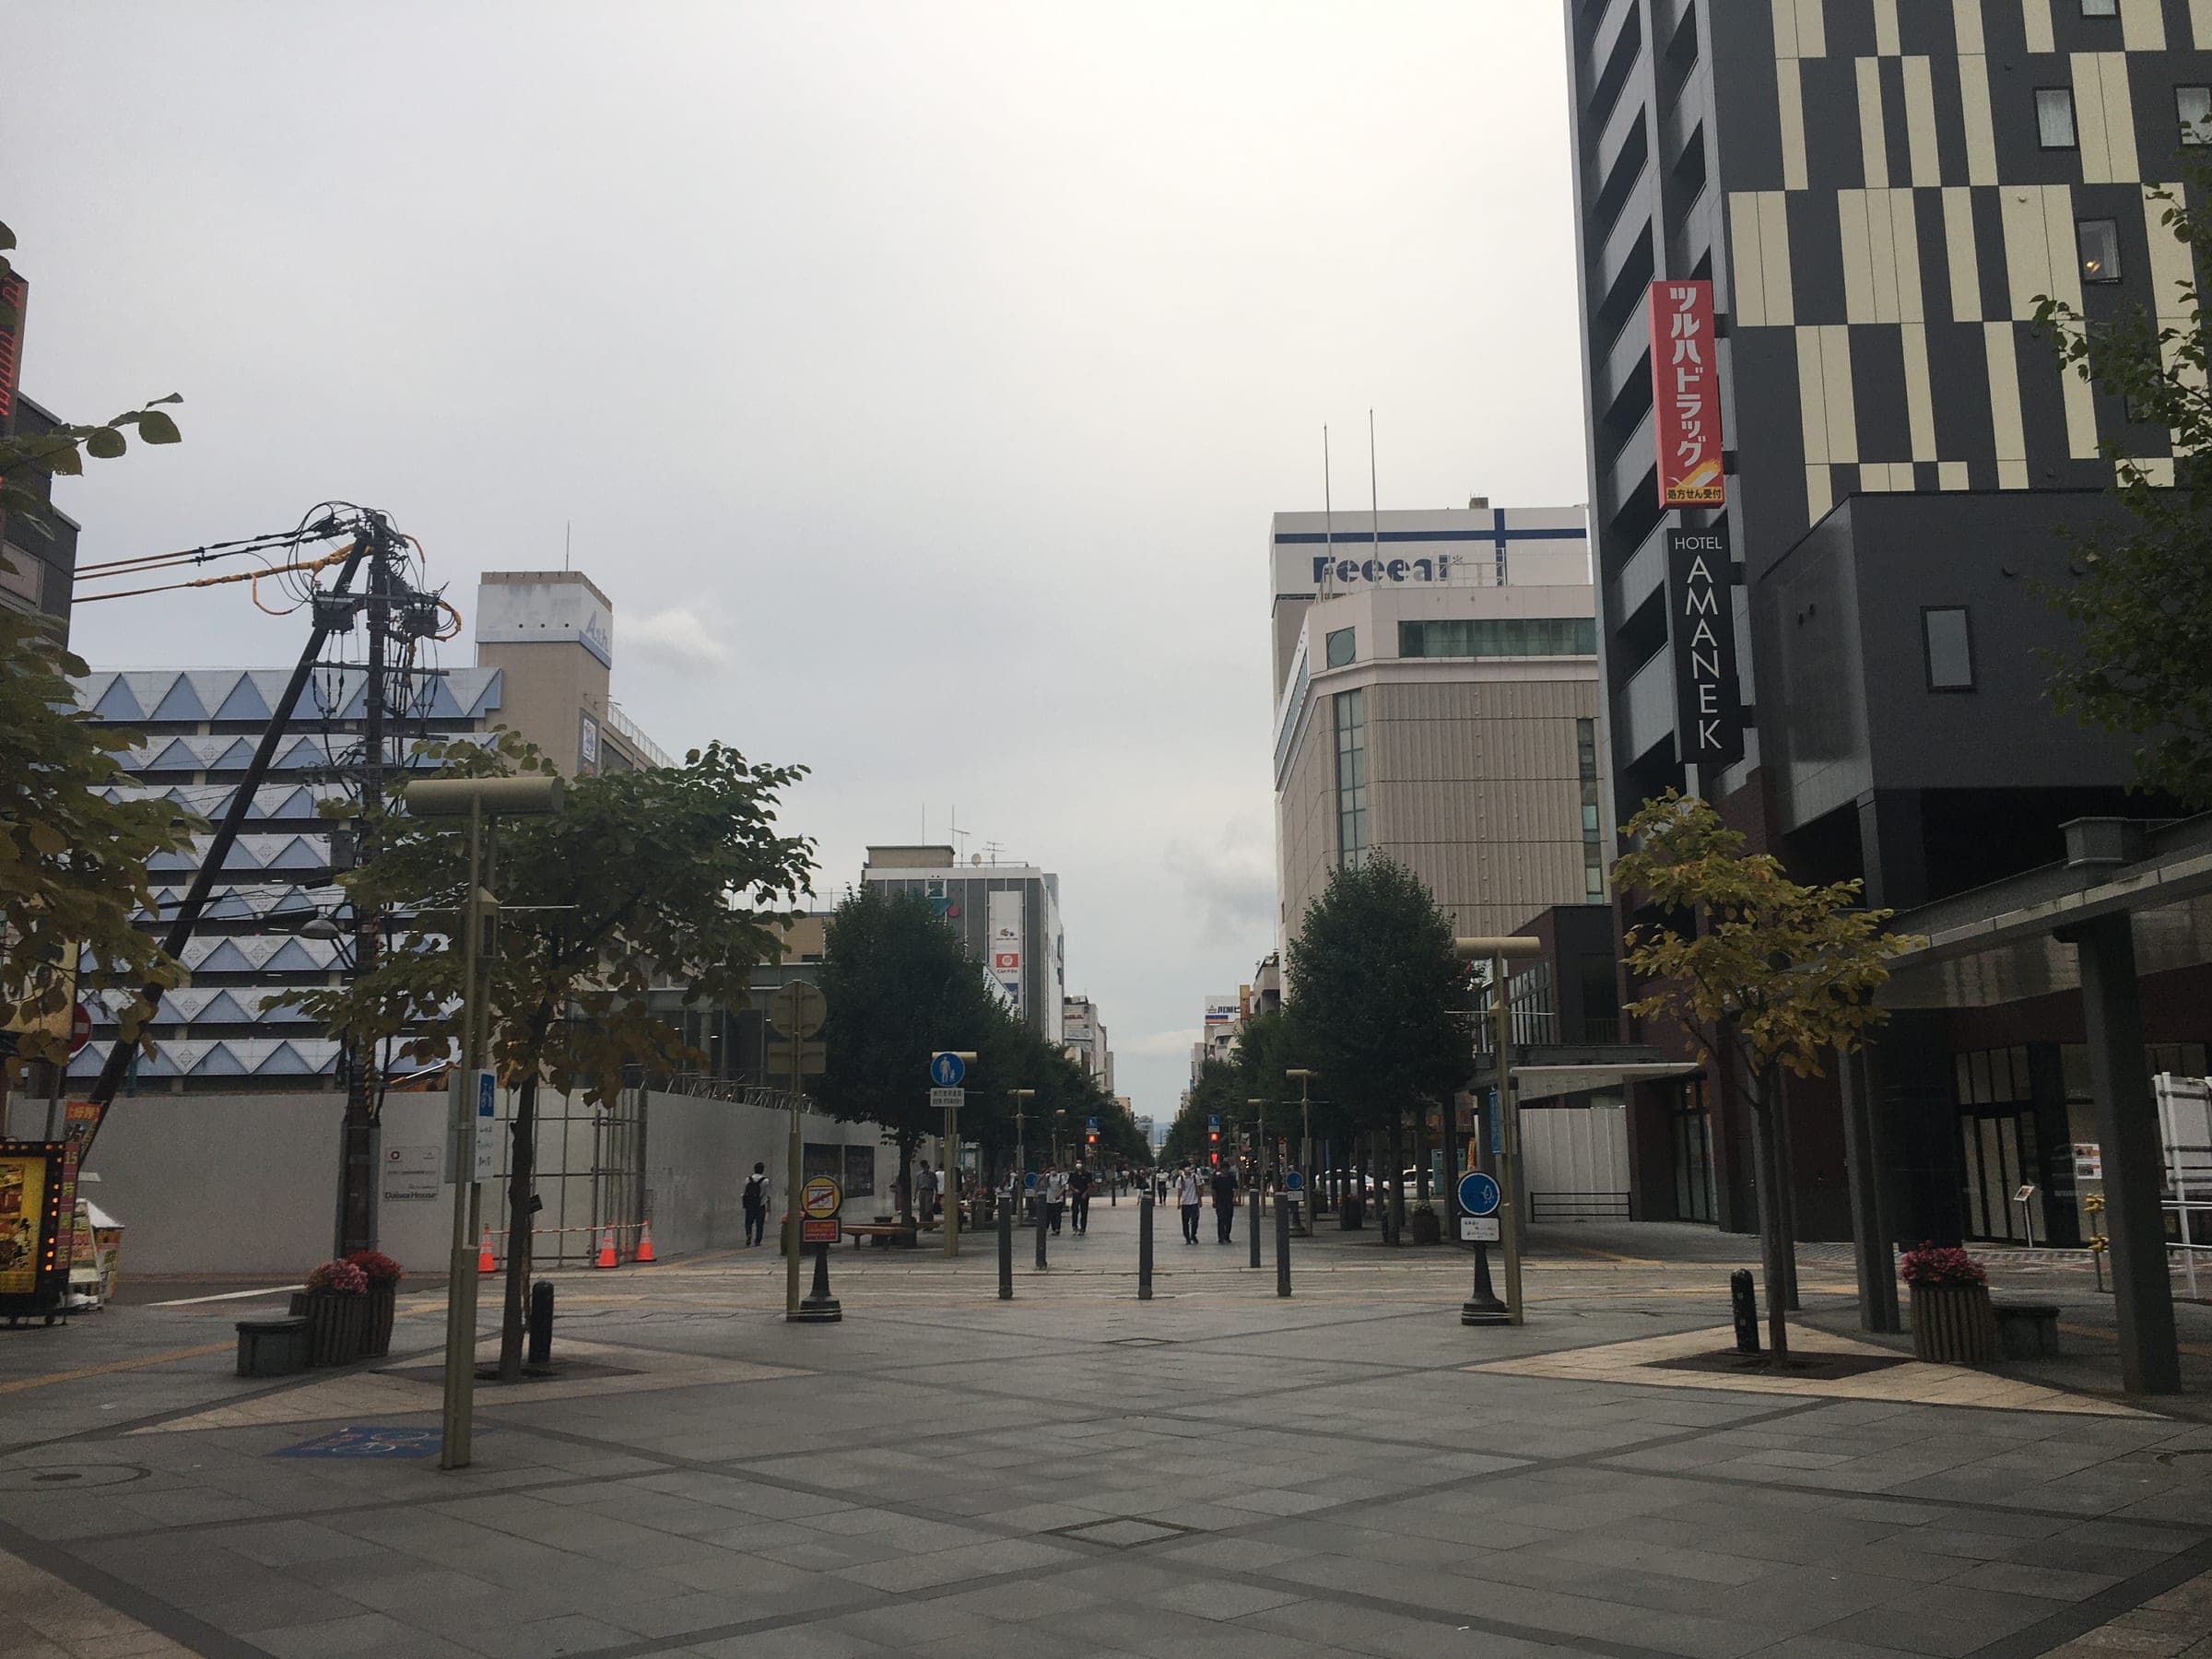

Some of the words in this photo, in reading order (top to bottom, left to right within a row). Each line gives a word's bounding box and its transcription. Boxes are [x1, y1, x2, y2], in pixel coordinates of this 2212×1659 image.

[1669, 287, 1707, 467] ツルハドラッグ
[1667, 488, 1722, 500] 処方せん受付
[1675, 536, 1723, 550] HOTEL
[1686, 556, 1723, 749] AMANEK
